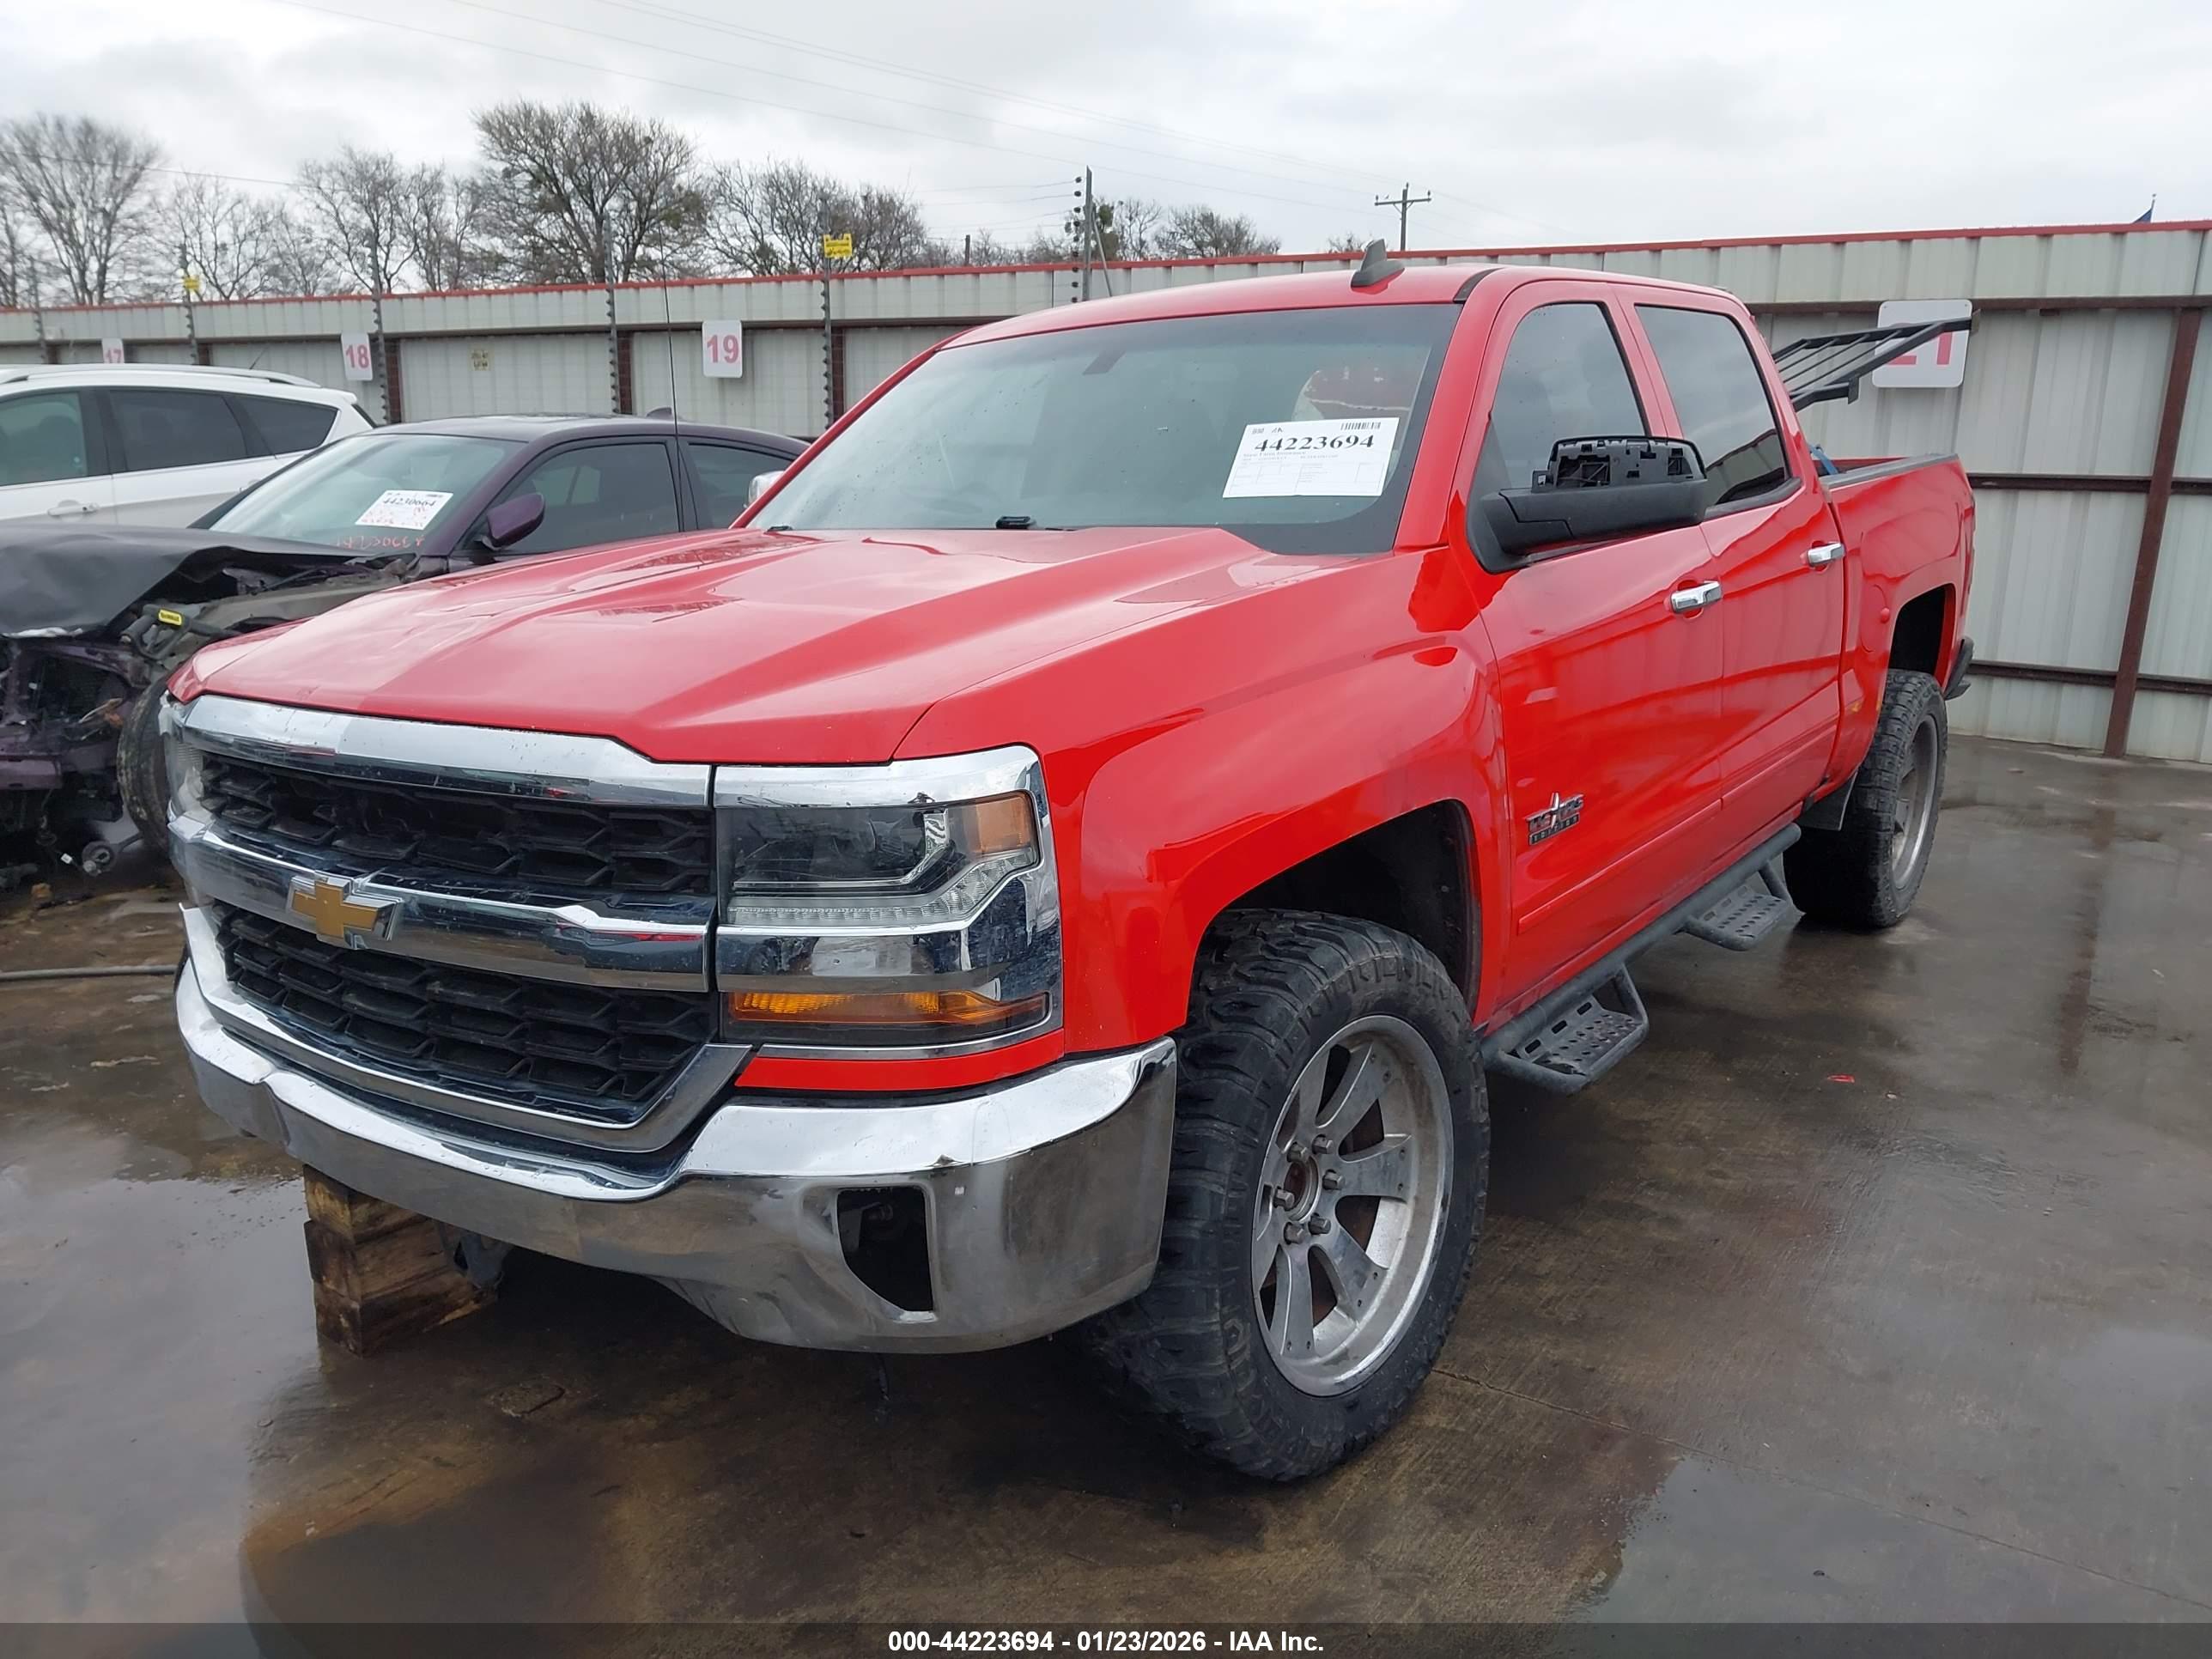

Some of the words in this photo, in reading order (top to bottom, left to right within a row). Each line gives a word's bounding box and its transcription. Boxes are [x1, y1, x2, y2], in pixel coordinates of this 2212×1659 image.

[345, 343, 369, 369] 18
[707, 334, 739, 363] 19
[1254, 434, 1375, 453] 44223694
